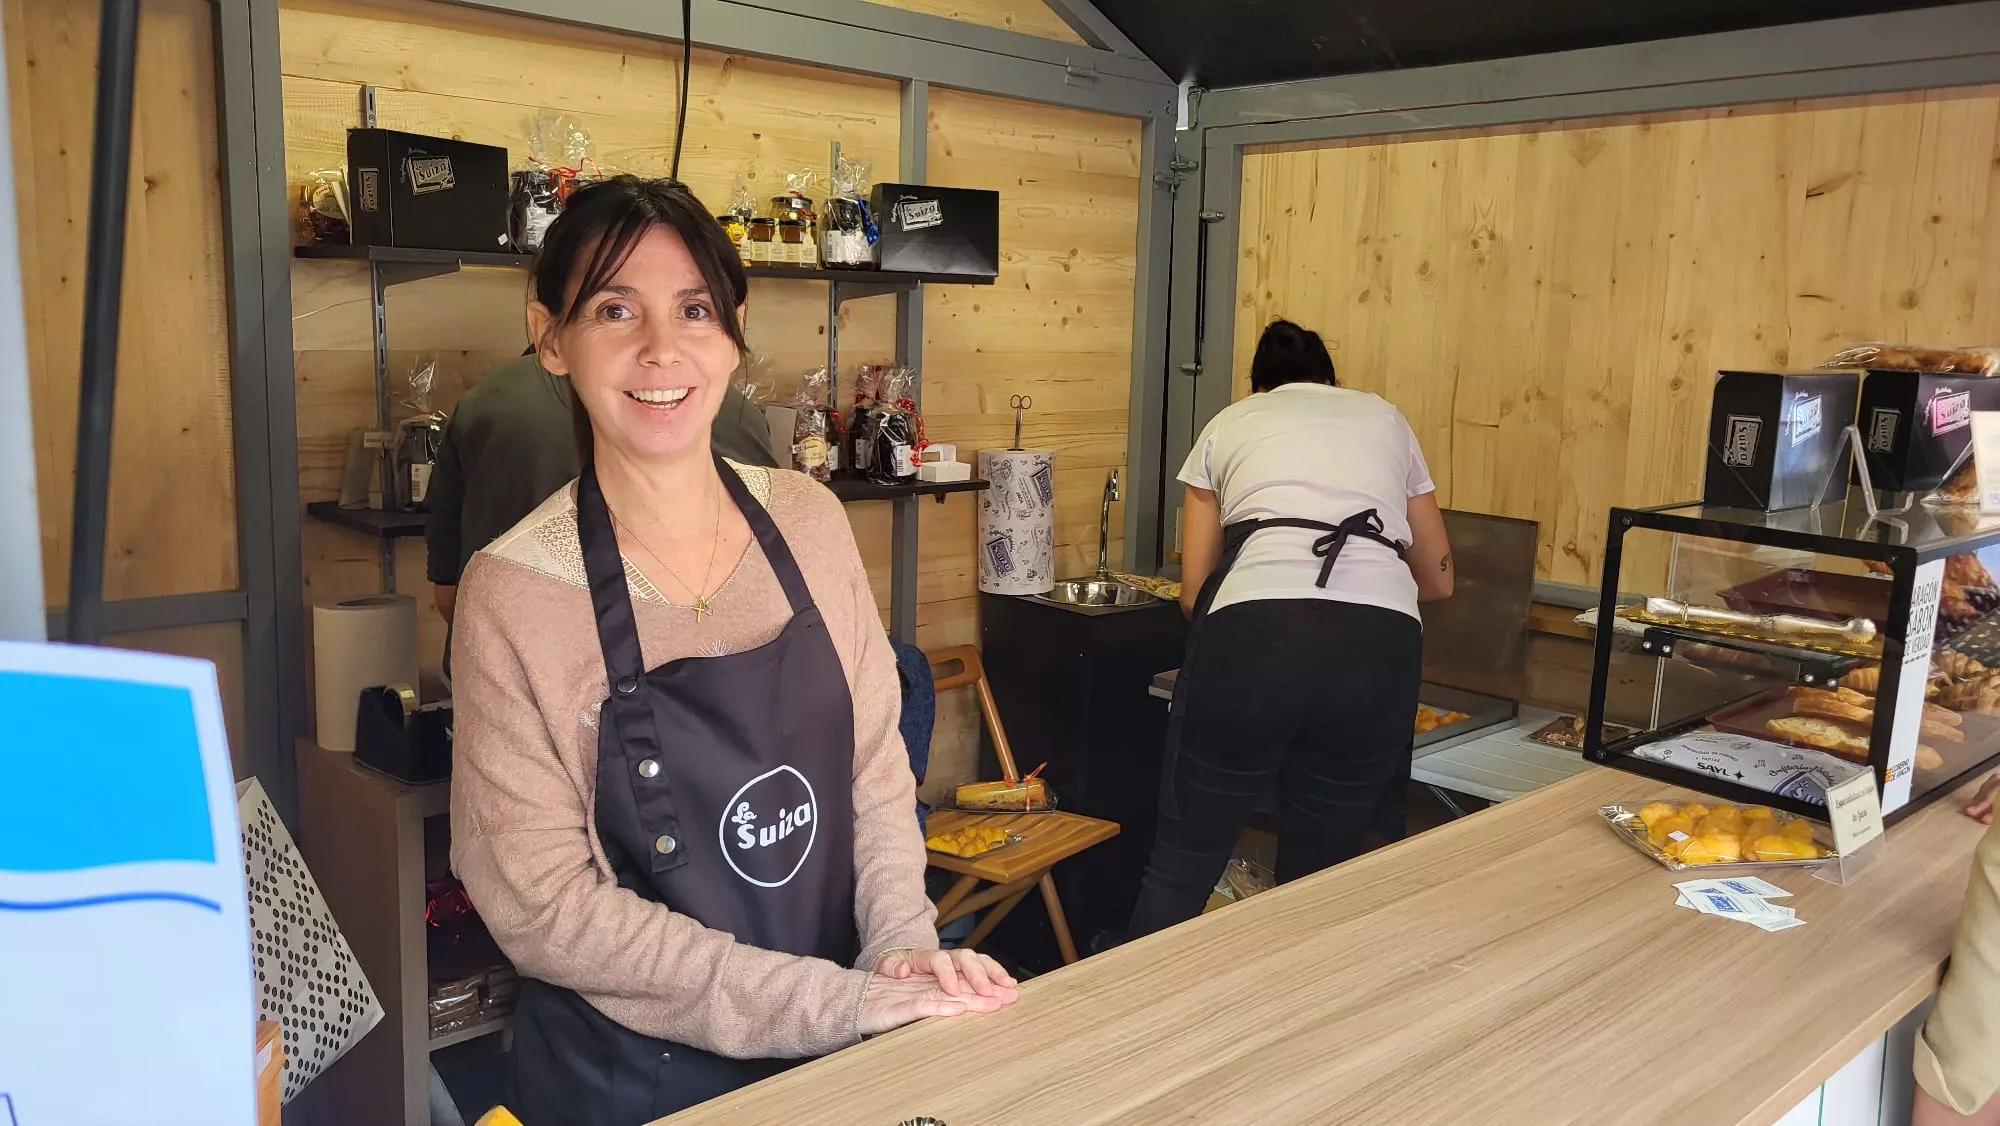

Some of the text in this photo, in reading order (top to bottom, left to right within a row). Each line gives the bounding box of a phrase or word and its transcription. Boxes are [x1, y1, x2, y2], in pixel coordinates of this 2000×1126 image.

[1738, 426, 1749, 461] Suiza
[1697, 762, 1731, 777] SAYL
[731, 801, 758, 824] La
[737, 802, 812, 850] Suiza
